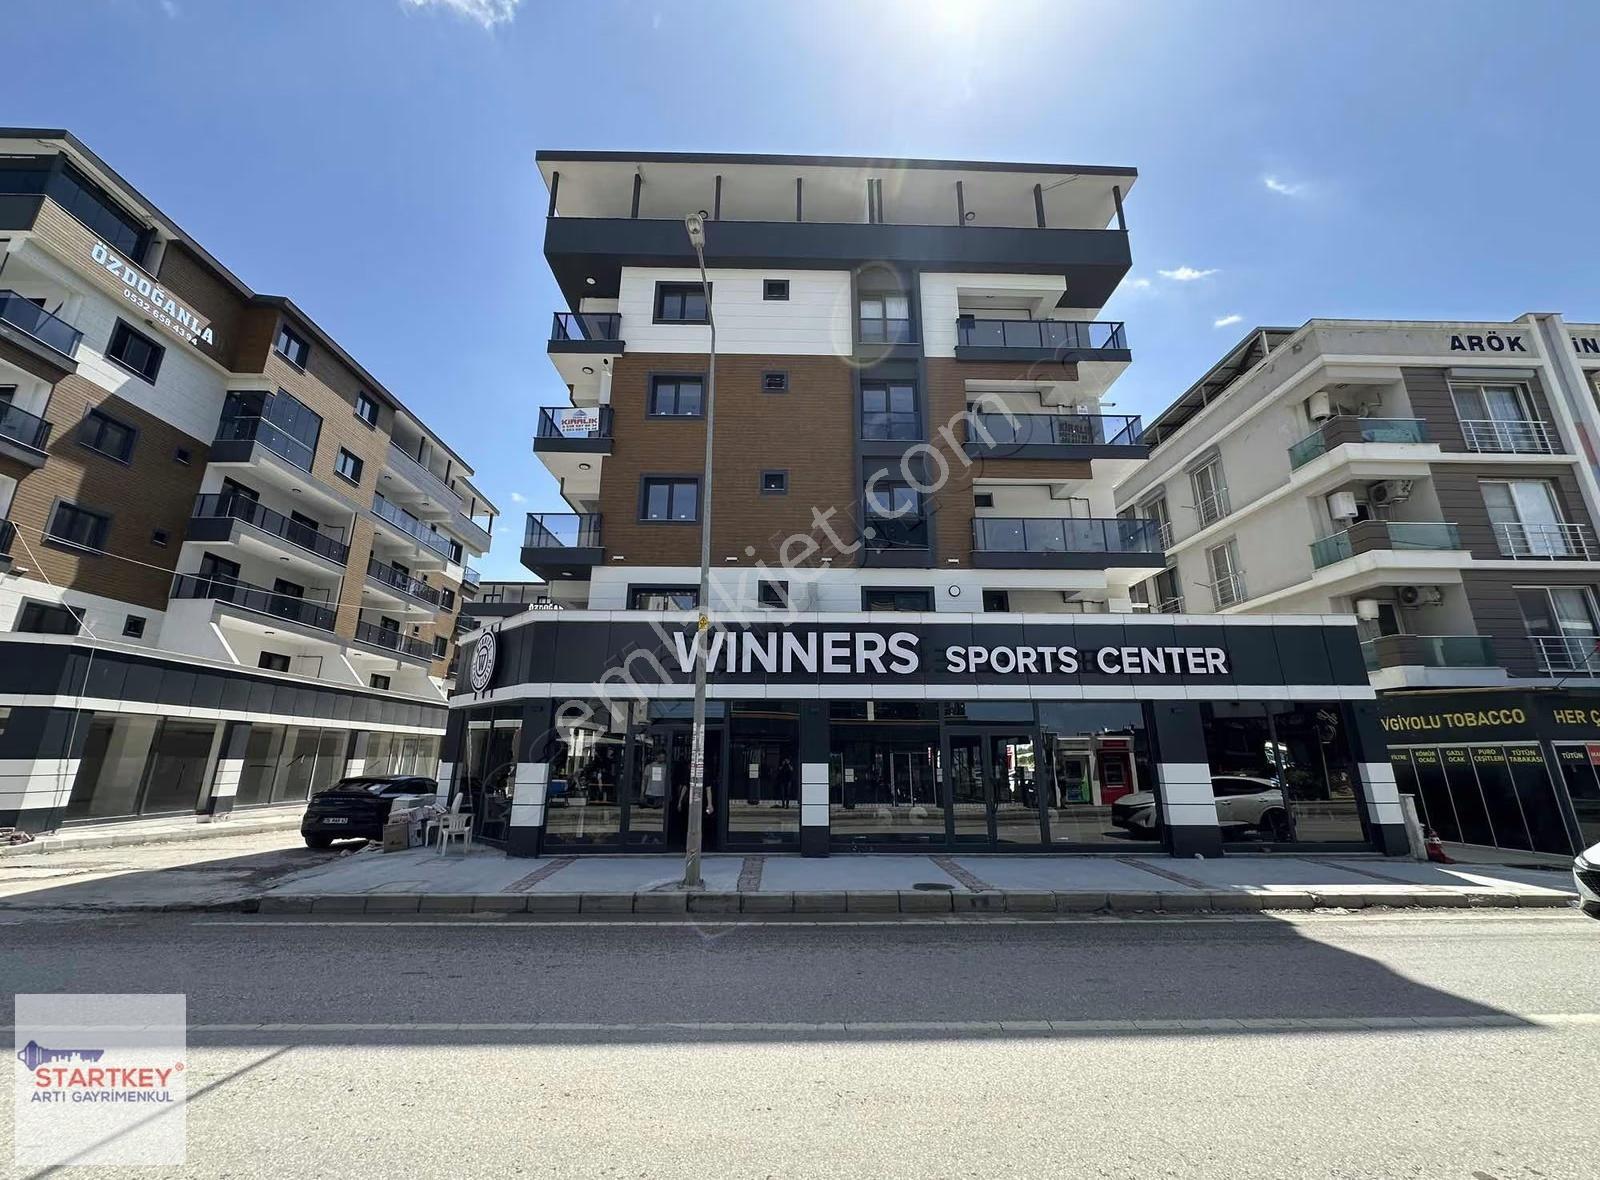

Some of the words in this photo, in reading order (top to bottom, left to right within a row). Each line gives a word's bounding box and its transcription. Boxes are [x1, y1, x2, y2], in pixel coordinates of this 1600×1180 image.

[91, 240, 213, 345] ÖZDOĞANLA
[123, 289, 150, 312] 0532
[153, 310, 171, 327] 658
[173, 325, 185, 337] 43
[1450, 331, 1526, 352] ARÖK
[674, 632, 919, 674] WINNERS
[945, 645, 1078, 673] SPORTS
[1097, 647, 1229, 674] CENTER
[1443, 708, 1526, 728] TOBACCO
[1553, 710, 1587, 724] HER
[1561, 751, 1584, 759] TÜTÜN
